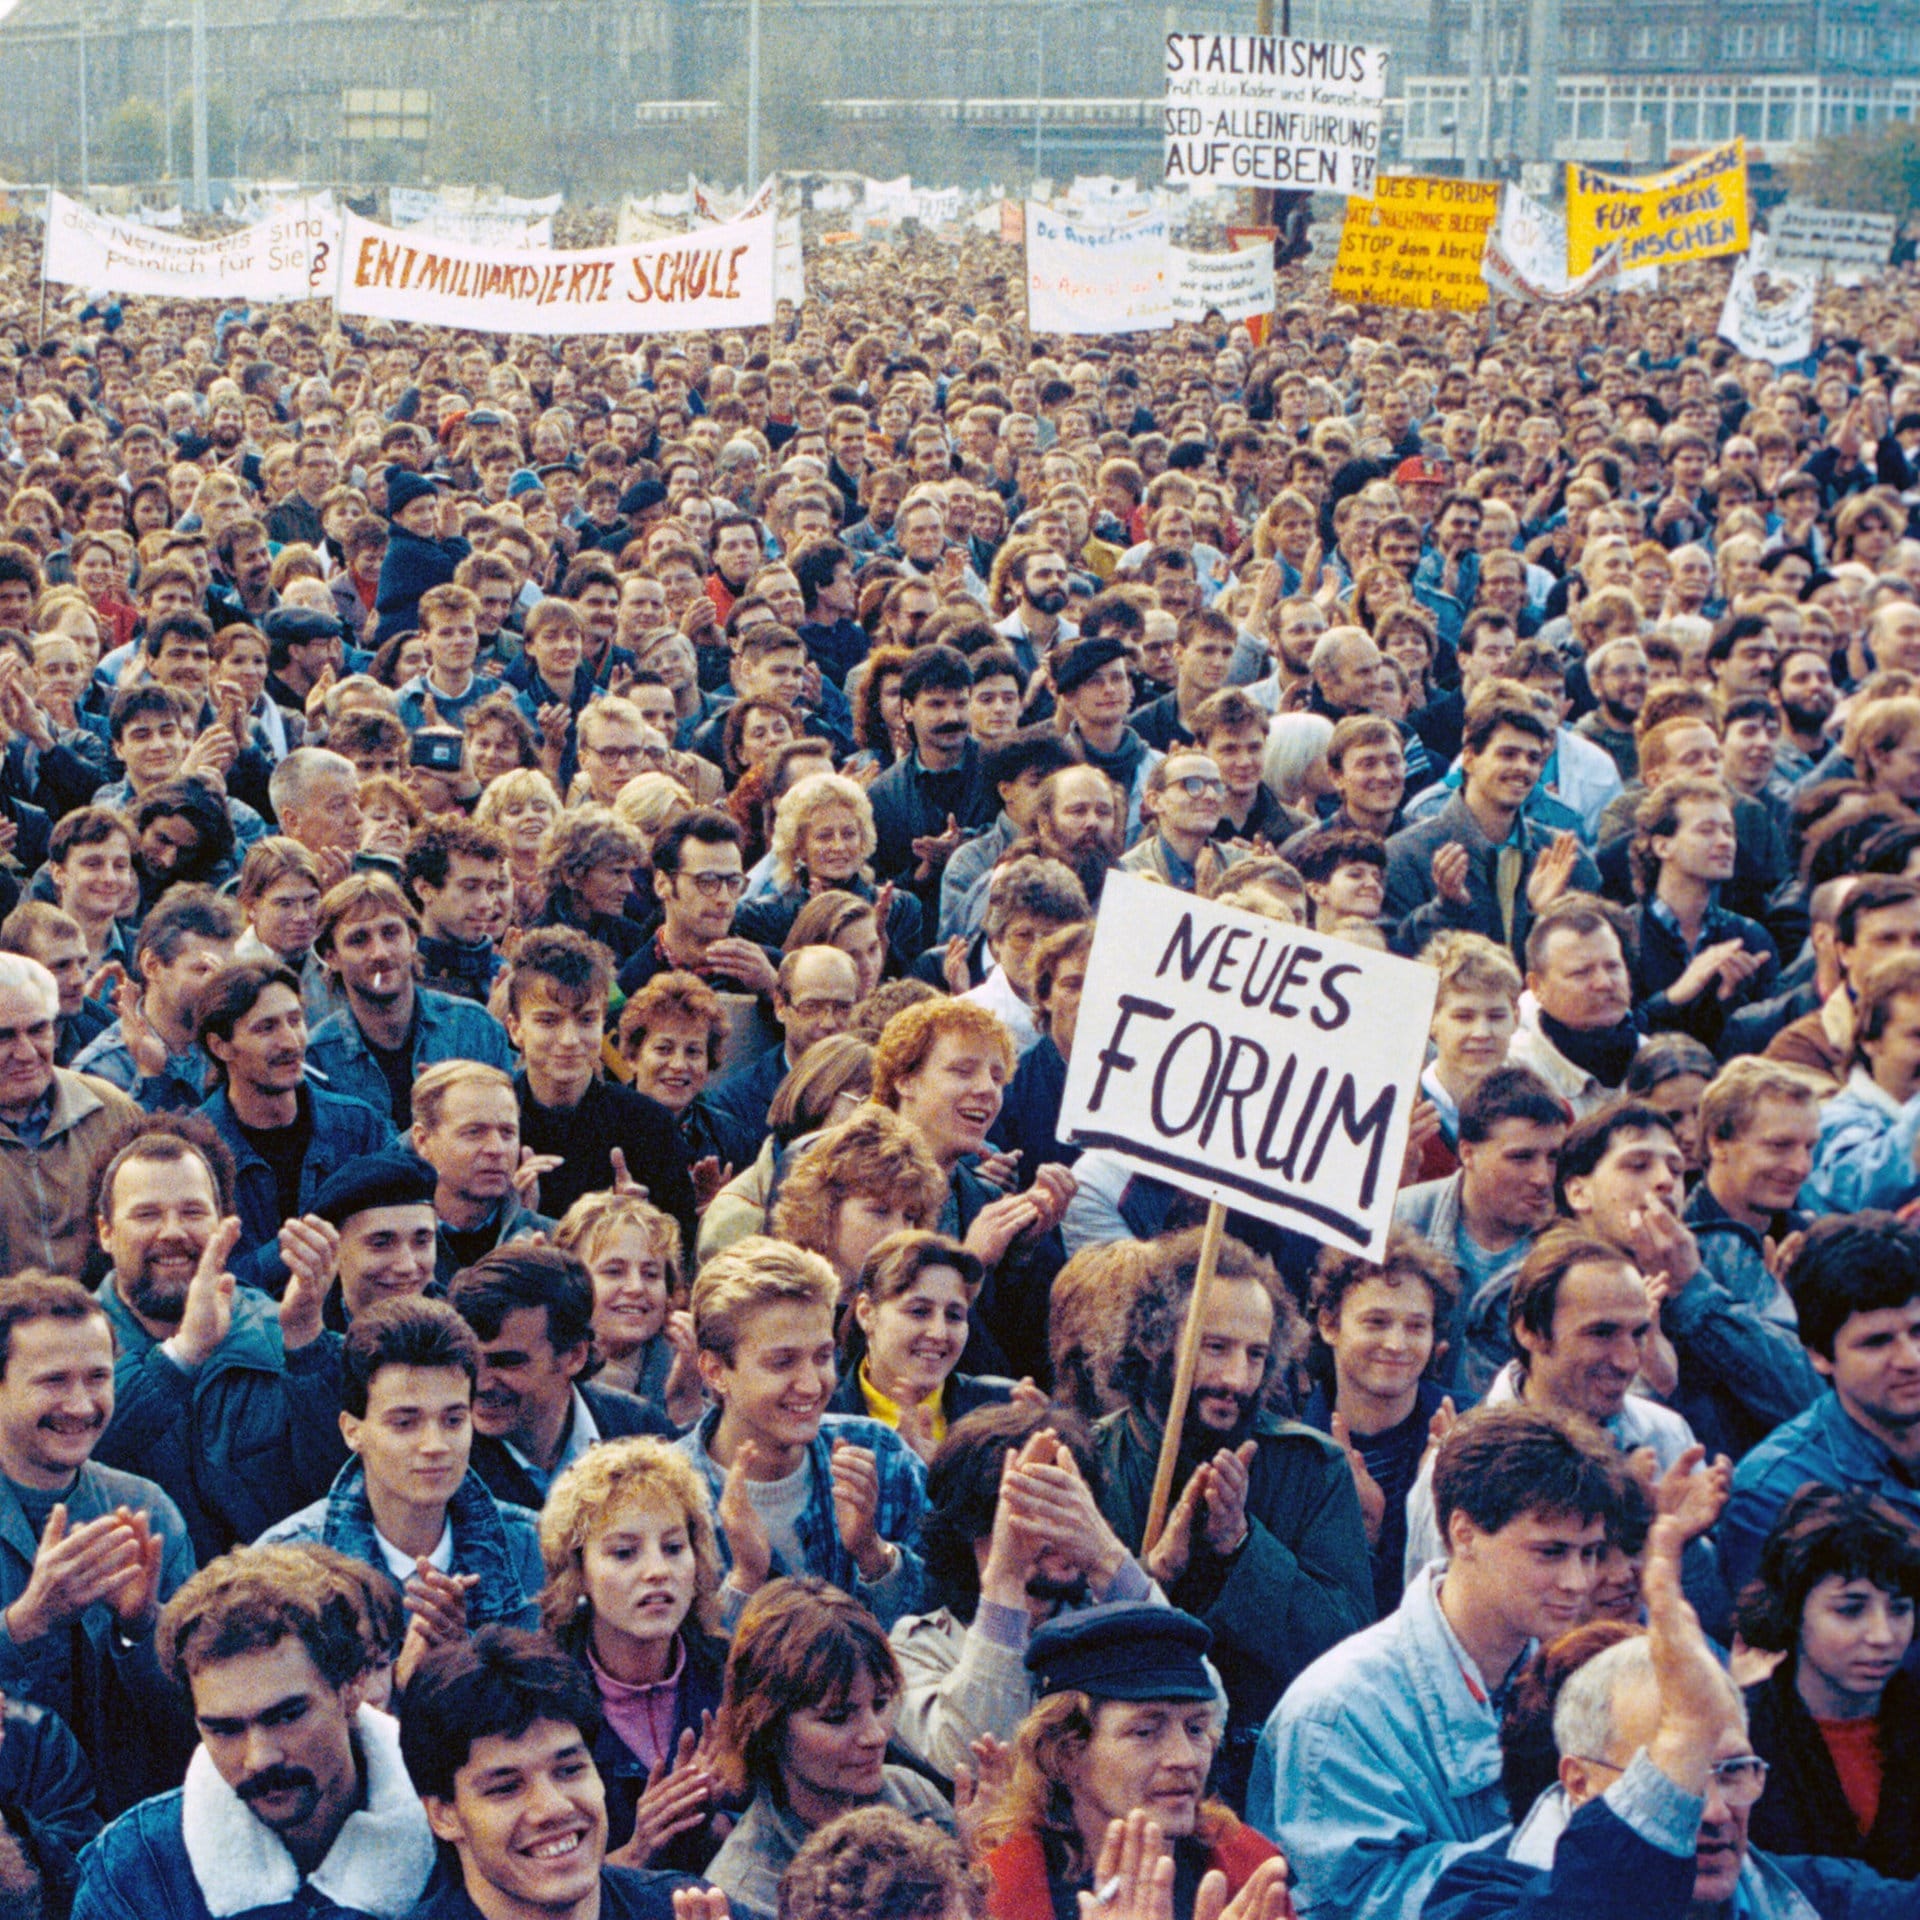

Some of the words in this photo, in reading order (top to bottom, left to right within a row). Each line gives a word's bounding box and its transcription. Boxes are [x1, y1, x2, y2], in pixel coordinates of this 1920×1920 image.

[1165, 32, 1366, 82] STALINISMUS
[1164, 142, 1337, 184] AUFGEBEN
[1427, 178, 1499, 204] FORUM
[270, 212, 323, 243] sind
[1595, 202, 1643, 230] FÜR
[268, 246, 305, 272] Sie
[1344, 233, 1395, 254] STOP
[626, 244, 749, 304] SCHULE
[1154, 911, 1363, 1031] NEUES
[1086, 993, 1398, 1210] FORUM
